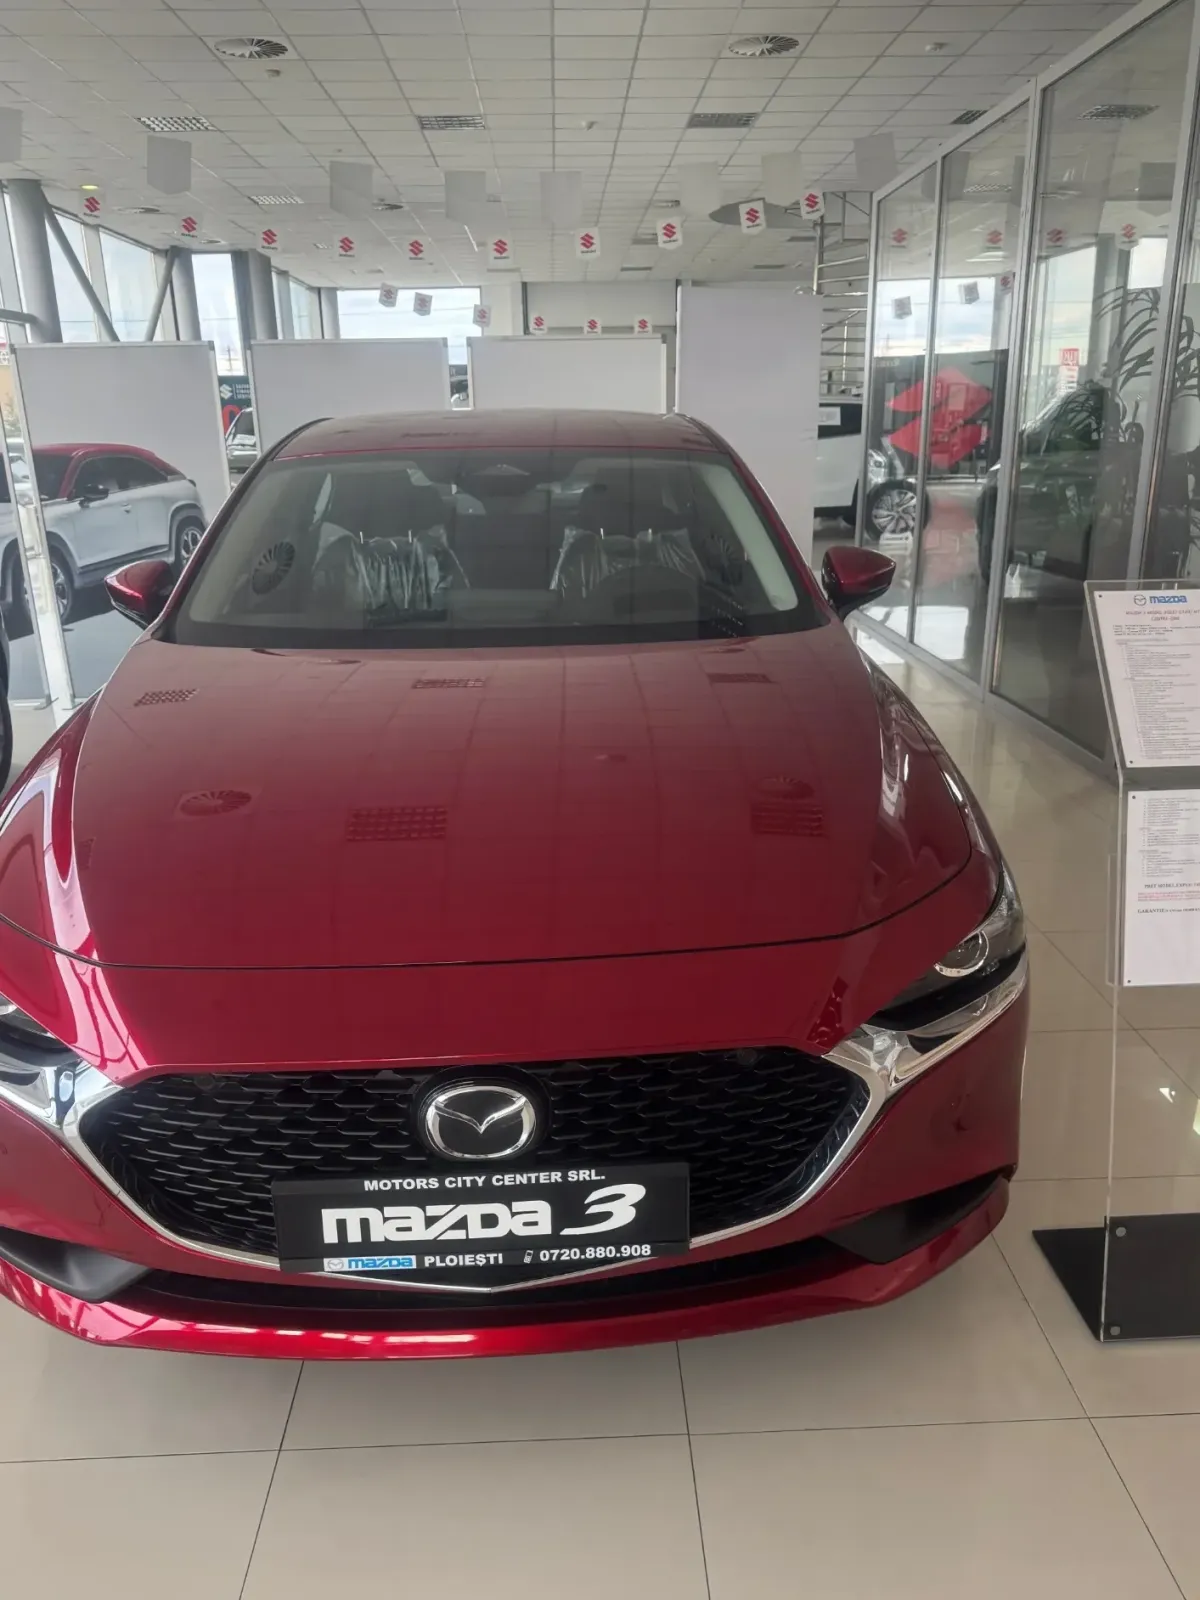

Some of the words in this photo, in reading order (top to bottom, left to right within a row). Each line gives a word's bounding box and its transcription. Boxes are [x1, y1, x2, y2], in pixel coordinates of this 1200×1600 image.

[1149, 595, 1188, 604] mazda
[364, 1177, 439, 1192] MOTORS
[444, 1175, 486, 1188] CITY
[492, 1171, 562, 1187] CENTER
[567, 1168, 606, 1182] SRL.
[321, 1199, 552, 1244] mazda
[559, 1183, 647, 1235] 3
[539, 1244, 651, 1262] 0720.880.908
[347, 1256, 413, 1270] mazda
